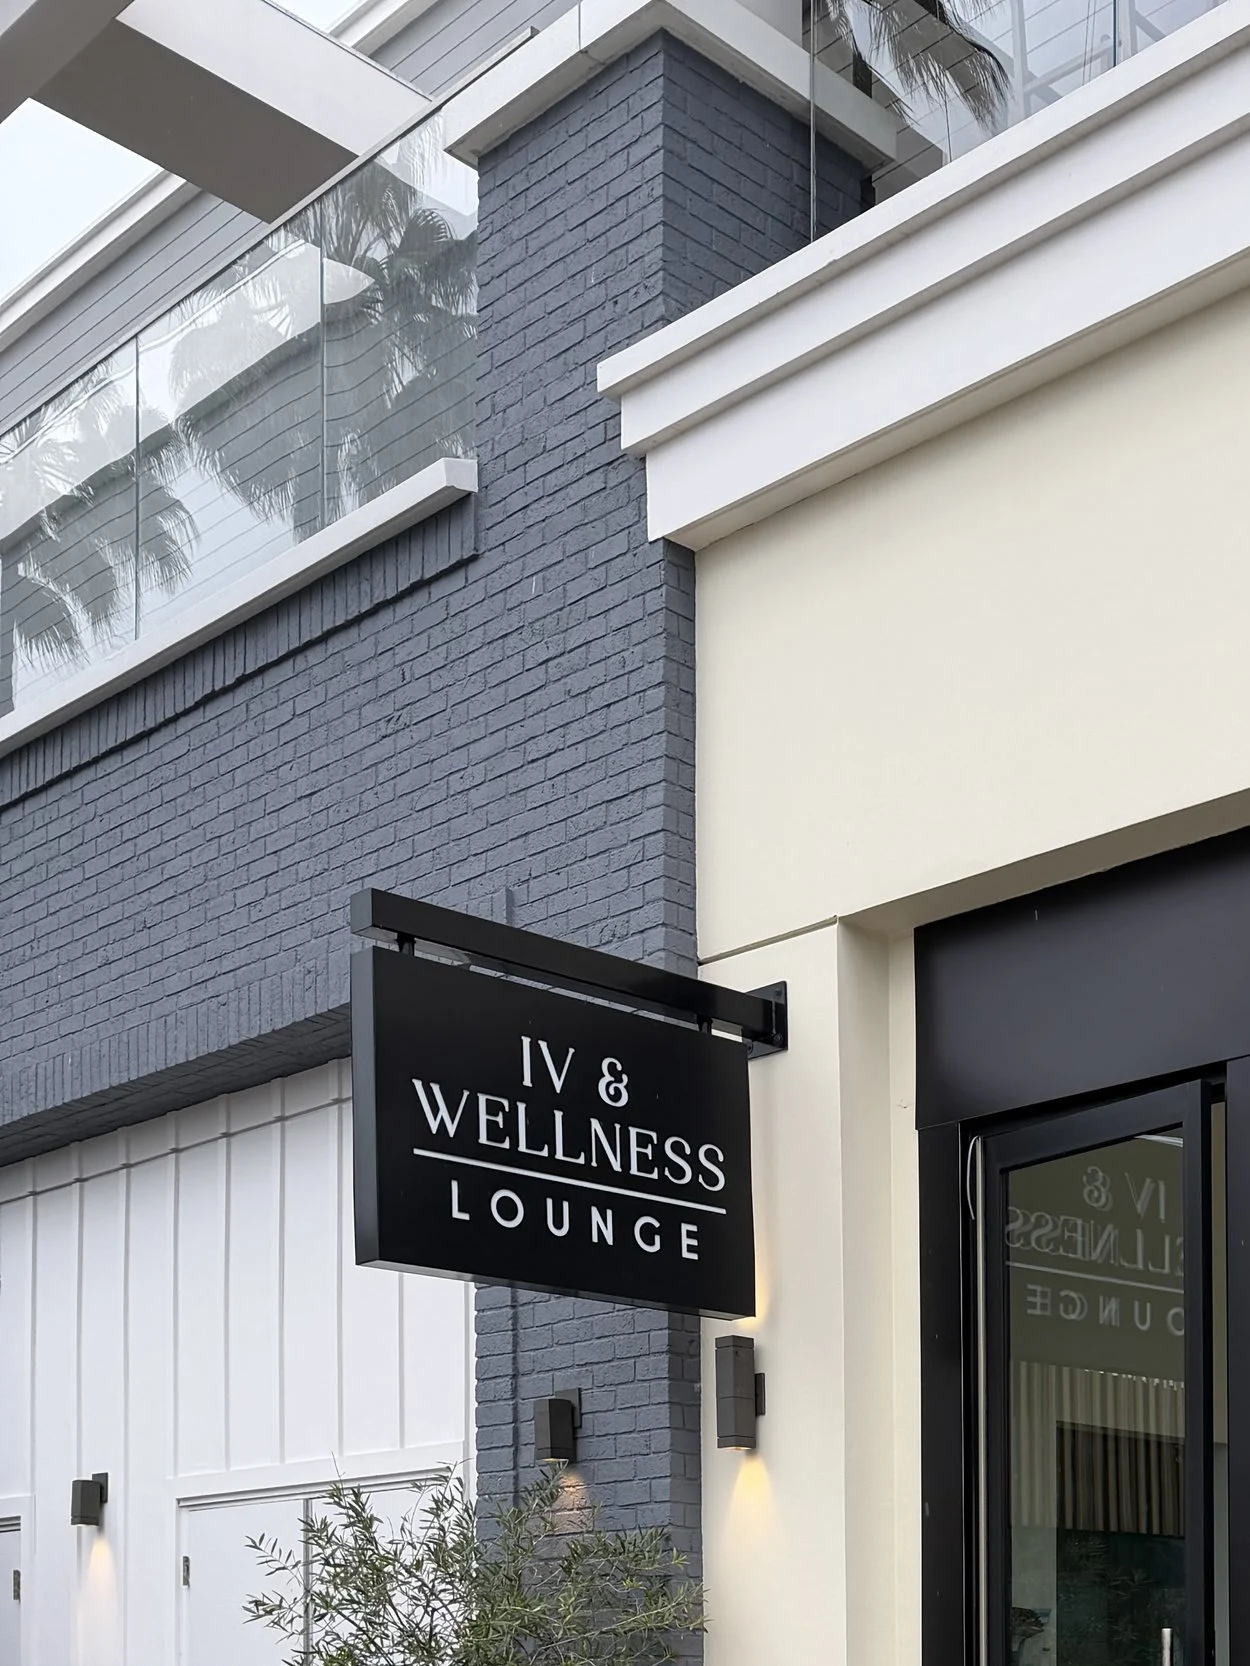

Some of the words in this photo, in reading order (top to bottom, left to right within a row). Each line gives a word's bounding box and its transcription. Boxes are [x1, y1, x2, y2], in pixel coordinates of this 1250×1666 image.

[520, 1035, 576, 1095] IV
[597, 1056, 630, 1108] &
[410, 1078, 727, 1193] WELLNESS
[450, 1179, 700, 1261] LOUNGE
